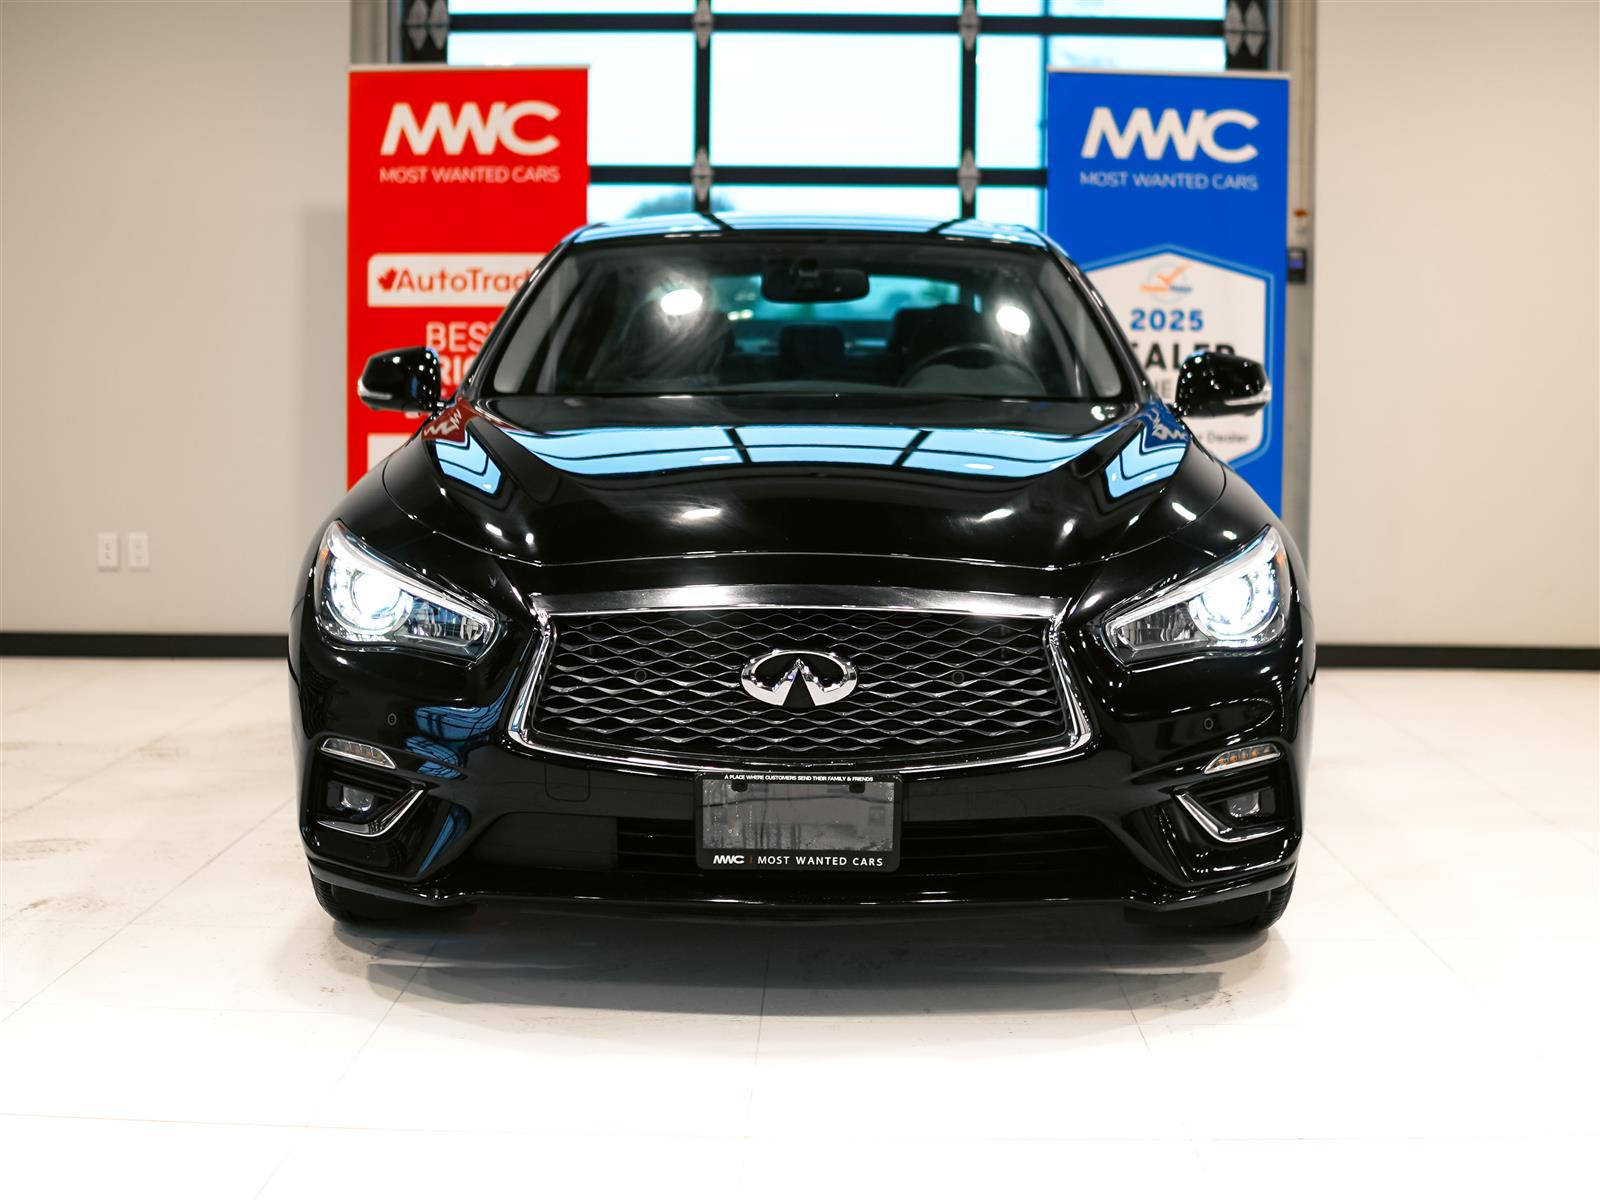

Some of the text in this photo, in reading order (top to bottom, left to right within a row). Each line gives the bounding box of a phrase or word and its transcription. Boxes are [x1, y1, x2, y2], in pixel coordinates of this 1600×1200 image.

[380, 100, 560, 156] MWC
[1081, 107, 1259, 163] MWC
[379, 166, 560, 183] MOST WANTED CARS
[1079, 171, 1258, 191] MOST WANTED CARS
[1130, 309, 1204, 332] 2025
[426, 321, 497, 352] BES
[712, 854, 884, 867] MWC MOST WANTED CARS
